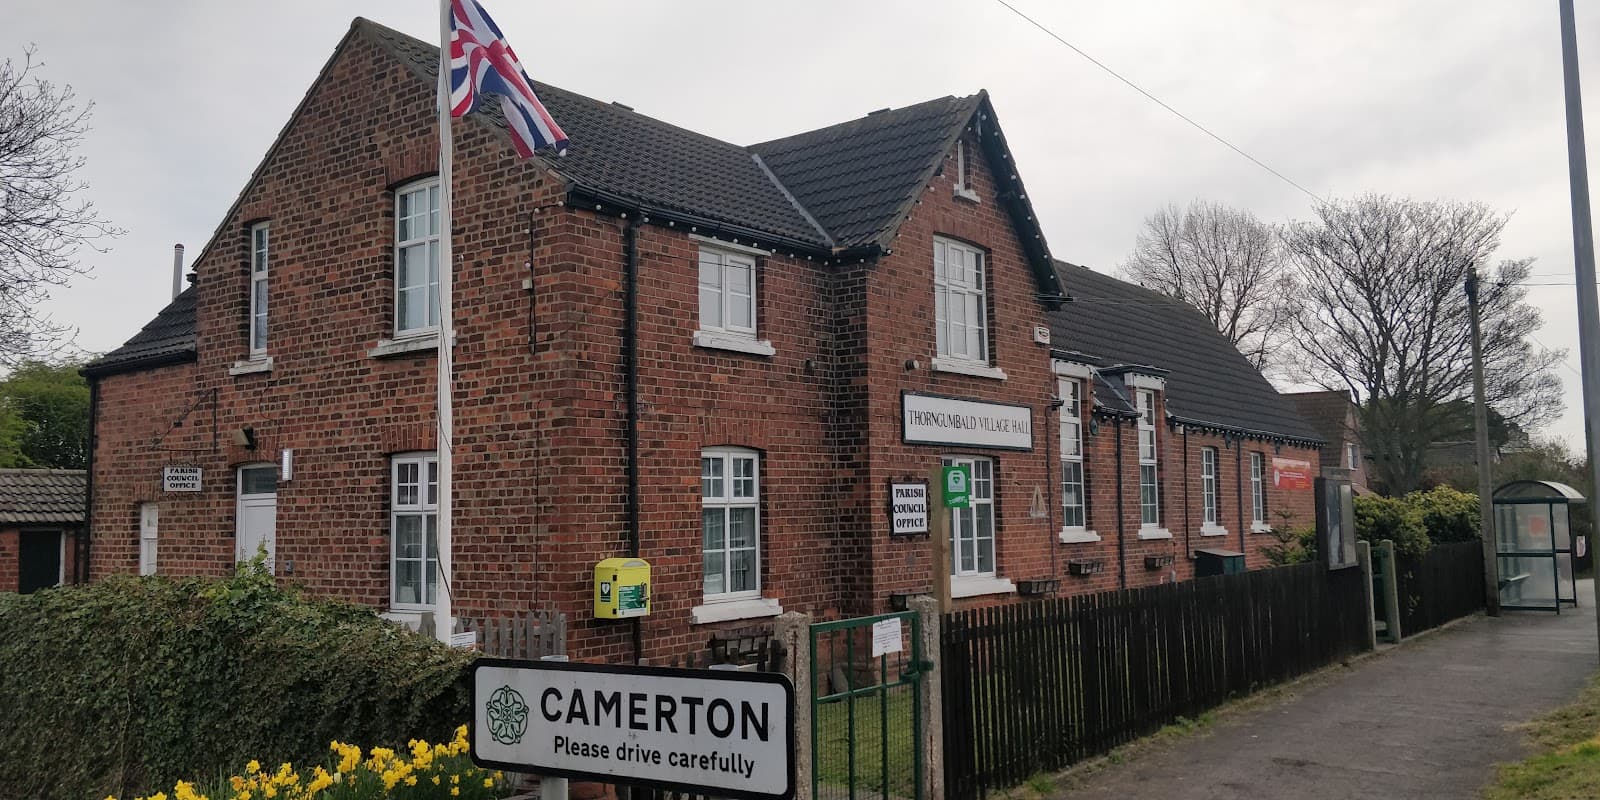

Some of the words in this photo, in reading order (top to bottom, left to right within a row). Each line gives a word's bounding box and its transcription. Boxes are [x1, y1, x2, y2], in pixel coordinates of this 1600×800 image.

[908, 410, 977, 430] THORNGUMBALD
[978, 416, 1010, 432] VILLAGE
[1012, 420, 1030, 434] HALL
[895, 488, 924, 498] PARISH
[893, 504, 926, 513] COUNCIL
[896, 518, 924, 528] OFFICE
[541, 687, 769, 742] CAMERTON
[554, 736, 610, 759] Please
[616, 742, 662, 764] drive
[668, 748, 755, 778] carefully
